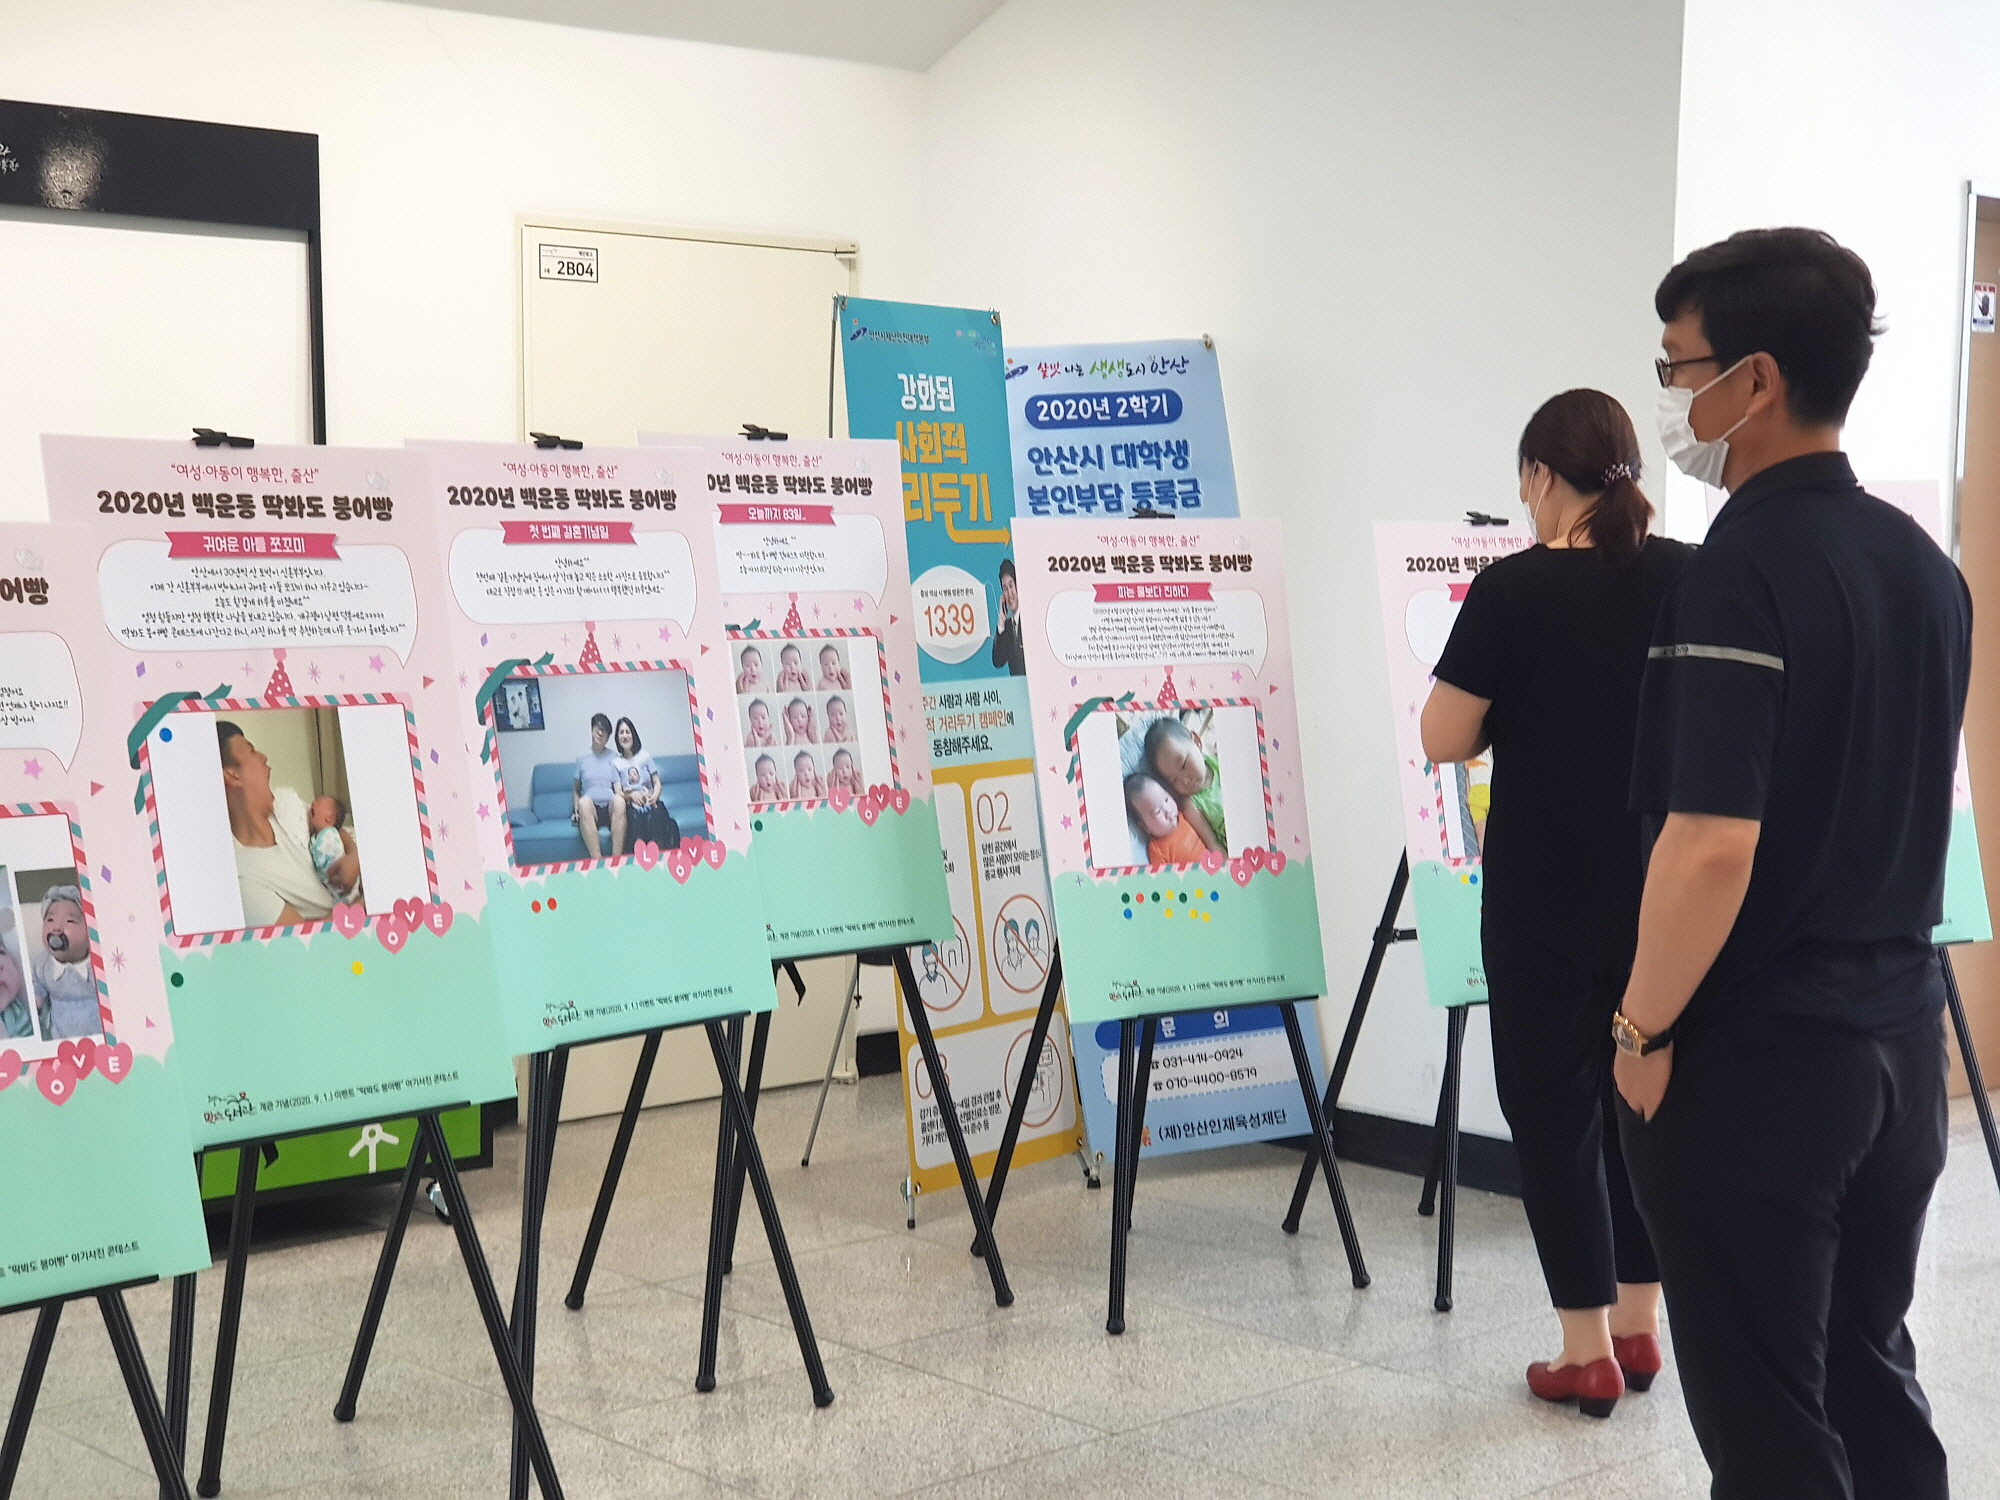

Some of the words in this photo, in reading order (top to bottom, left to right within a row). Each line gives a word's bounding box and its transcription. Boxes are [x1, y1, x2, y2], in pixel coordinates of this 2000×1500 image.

[557, 260, 594, 277] 2B04
[1150, 355, 1190, 375] 안산
[897, 373, 956, 412] 강화된
[1036, 396, 1111, 422] 2020년
[1116, 393, 1169, 419] 2학기
[896, 420, 968, 465] 사회적
[1027, 444, 1106, 476] 안산시
[1111, 439, 1191, 471] 대학생
[735, 474, 779, 494] 백운동
[783, 475, 826, 495] 딱봐도
[831, 476, 873, 496] 붕어빵
[97, 490, 186, 517] 2020년
[192, 492, 256, 519] 백운동
[262, 494, 326, 520] 딱봐도
[332, 495, 393, 521] 붕어빵
[447, 485, 515, 509] 2020년
[520, 487, 570, 510] 백운동
[574, 488, 625, 510] 딱봐도
[629, 488, 677, 511] 붕어빵
[1027, 482, 1125, 517] 본인부담
[1131, 477, 1204, 510] 등록금
[748, 507, 781, 521] 오늘까지
[529, 524, 539, 539] 첫
[542, 524, 561, 539] 번째
[563, 524, 609, 539] 결혼기념일
[203, 536, 239, 553] 귀여운
[242, 536, 267, 553] 아들
[270, 537, 306, 553] 쪼꼬미
[1048, 556, 1106, 573] 2020년
[1111, 555, 1155, 573] 백운동
[1159, 554, 1204, 573] 딱봐도
[1208, 554, 1253, 572] 붕어빵
[1406, 556, 1460, 573] 2020년
[1118, 586, 1135, 598] 피는
[924, 603, 975, 637] 1339
[939, 692, 963, 710] 사람과
[964, 691, 981, 708] 사람
[983, 689, 1002, 706] 사이,
[926, 716, 936, 735] 적
[939, 712, 977, 732] 거리두기
[933, 735, 993, 757] 동참해주세요.
[977, 790, 1012, 835] 02
[1160, 1016, 1176, 1038] 문
[1213, 1010, 1229, 1029] 의
[1163, 1047, 1244, 1068] 031-414-0924
[1158, 1108, 1287, 1142] (재)안산인재육성재단
[107, 1241, 140, 1257] 콘테스트
